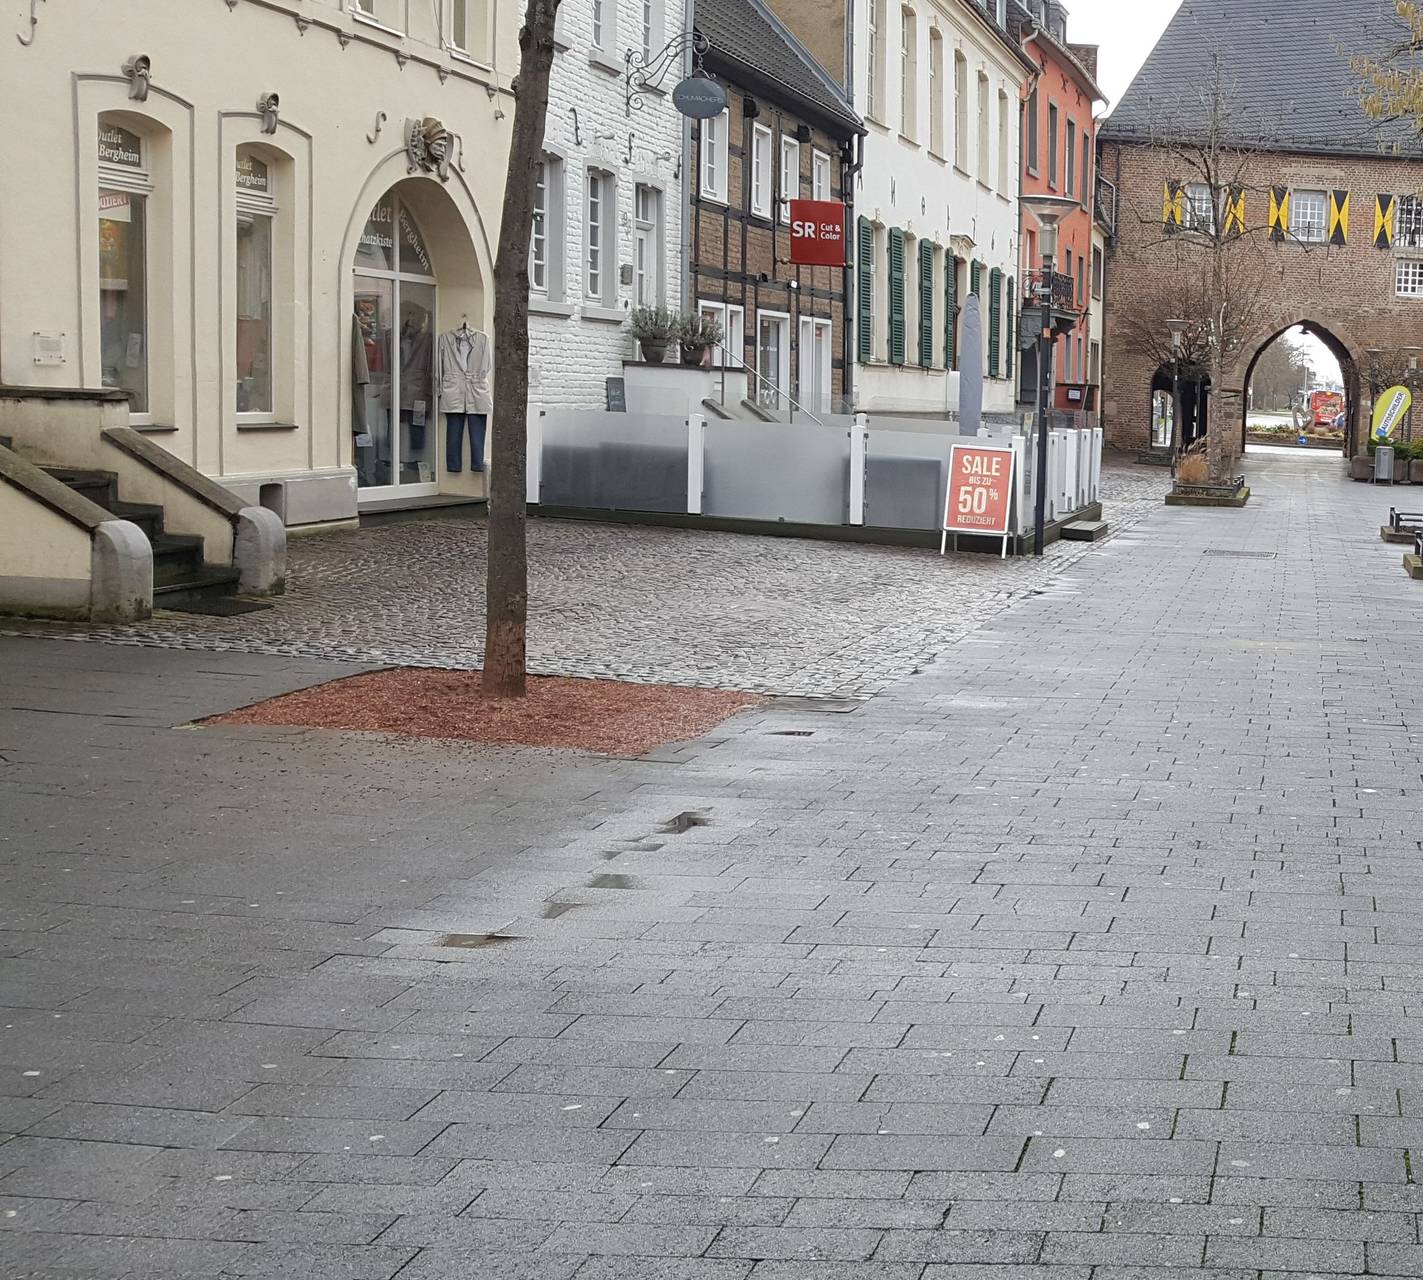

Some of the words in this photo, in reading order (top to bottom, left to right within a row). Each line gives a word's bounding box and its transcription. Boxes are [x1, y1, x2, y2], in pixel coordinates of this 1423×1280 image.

[98, 143, 140, 162] Bergheim
[236, 158, 253, 171] utlet
[236, 171, 267, 187] Bergheim
[368, 201, 393, 223] tlet
[792, 220, 816, 238] SR
[820, 223, 833, 231] Cut
[835, 224, 841, 232] &
[820, 231, 840, 240] Color
[360, 232, 393, 248] hatzkiste
[1380, 391, 1405, 432] AUTOSCHILDER
[961, 455, 1002, 476] SALE
[968, 476, 981, 484] BIS
[982, 477, 993, 486] ZU
[957, 514, 996, 525] REDUZIERT
